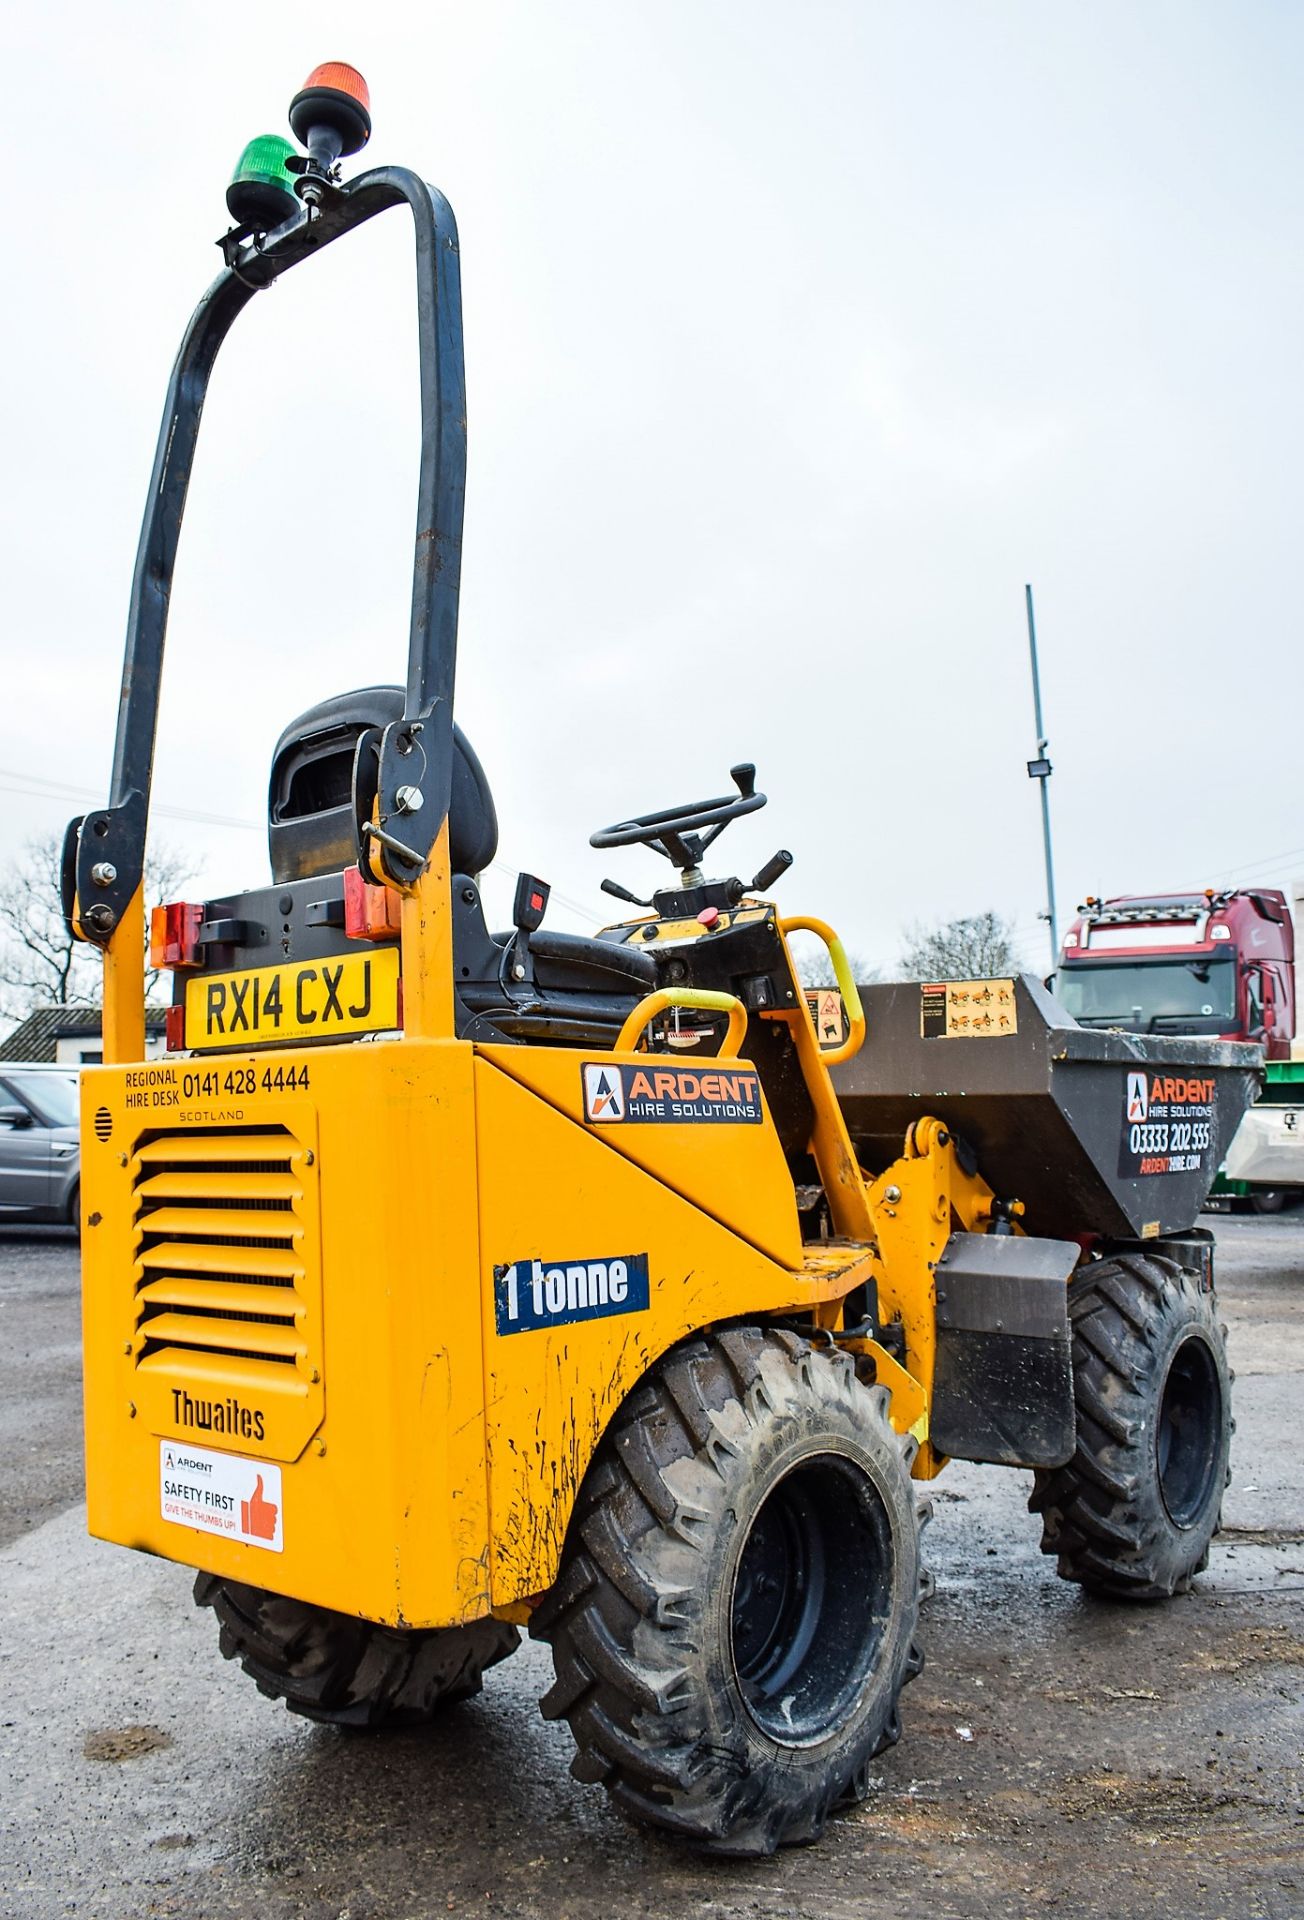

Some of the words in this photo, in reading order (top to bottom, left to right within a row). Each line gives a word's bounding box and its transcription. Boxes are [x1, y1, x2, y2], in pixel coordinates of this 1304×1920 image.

[207, 974, 283, 1035] RX14
[296, 960, 371, 1024] CXJ
[126, 1069, 177, 1088] REGIONAL
[183, 1072, 219, 1098] 0141
[224, 1069, 256, 1095] 428
[261, 1065, 310, 1092] 4444
[629, 1072, 757, 1103] ARDENT
[1150, 1077, 1216, 1103] ARDENT
[126, 1092, 149, 1108] HIRE
[152, 1090, 179, 1107] DESK
[630, 1103, 666, 1117] HIRE
[673, 1103, 756, 1118] SOLUTIONS
[1149, 1105, 1168, 1118] HIRE
[1170, 1105, 1212, 1118] SOLUTIONS
[179, 1110, 244, 1122] SCOTLAND
[1130, 1123, 1168, 1154] 03333
[501, 1265, 519, 1321] 1
[532, 1260, 628, 1316] tonne
[171, 1388, 265, 1441] Thwaites
[177, 1457, 213, 1472] ARDENT
[164, 1480, 202, 1503] SAFETY
[205, 1491, 235, 1512] FIRST
[165, 1503, 179, 1516] GIVE
[181, 1507, 193, 1520] THE
[194, 1511, 223, 1528] THUMBS
[224, 1519, 236, 1531] UP!
